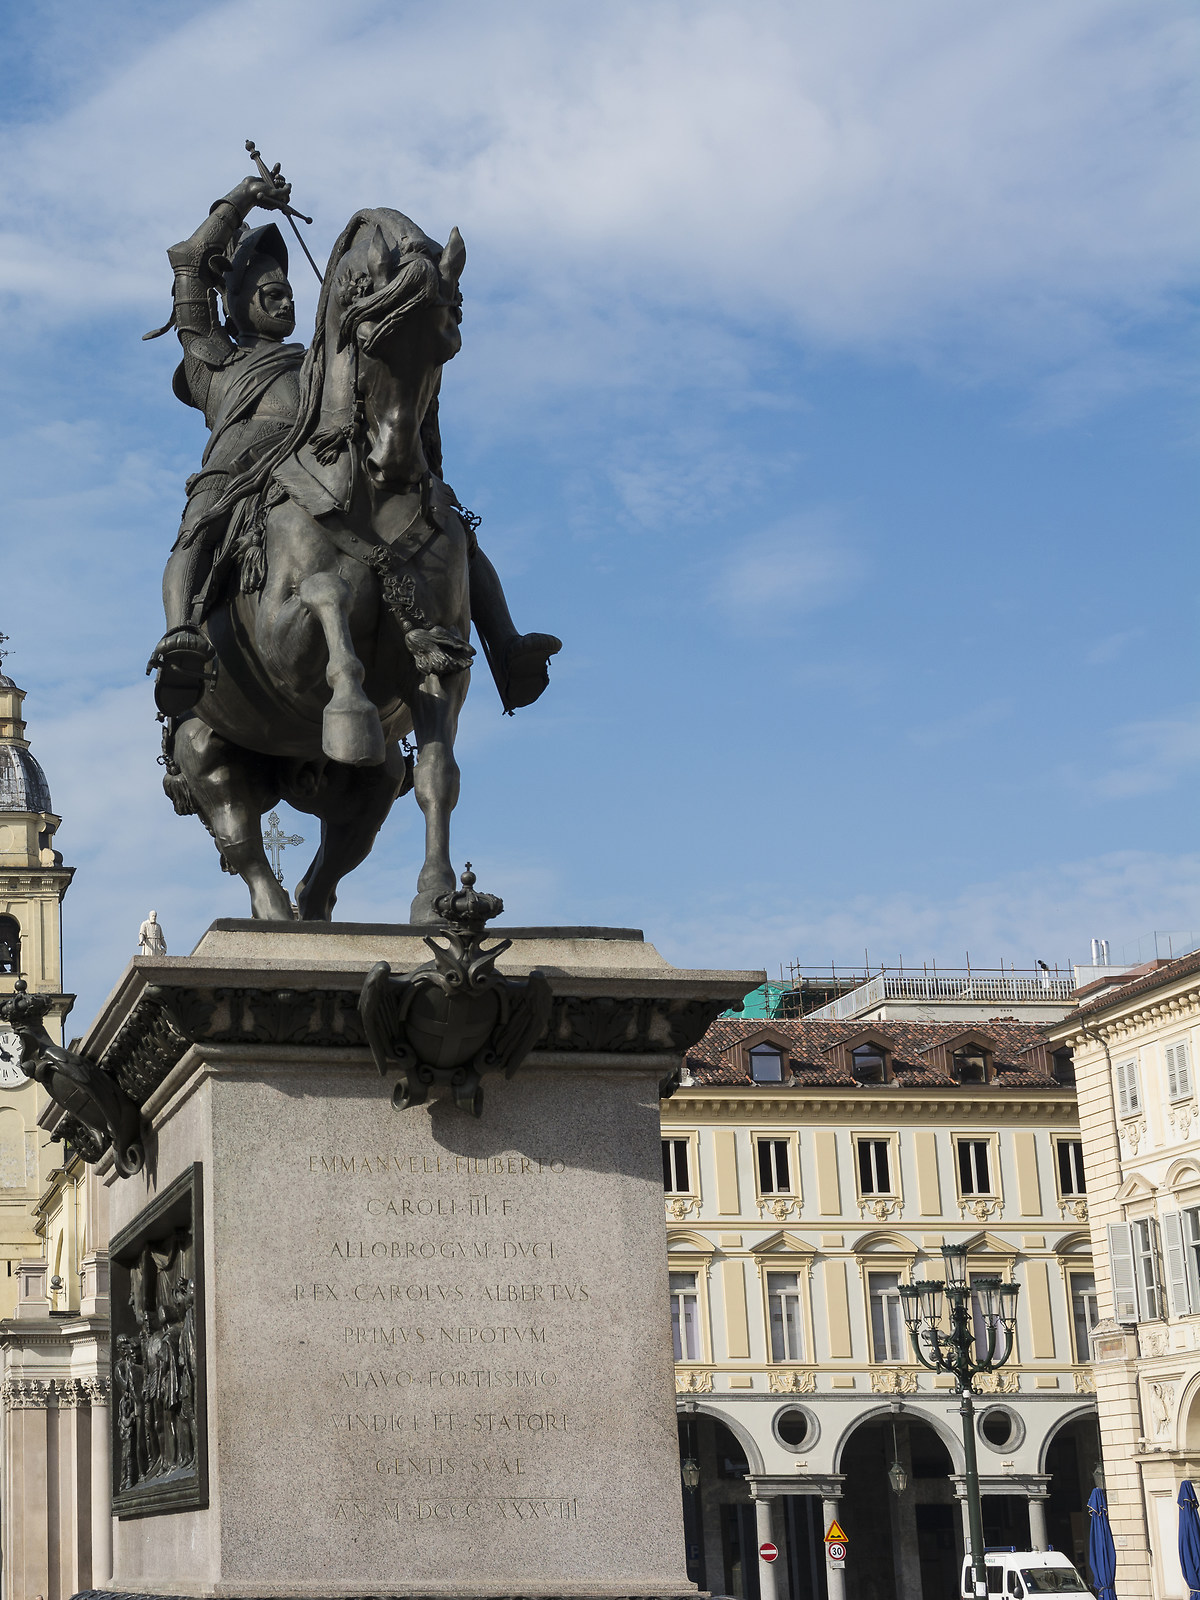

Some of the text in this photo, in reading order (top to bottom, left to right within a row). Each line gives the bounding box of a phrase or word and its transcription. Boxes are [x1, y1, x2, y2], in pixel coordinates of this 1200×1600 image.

[455, 1156, 567, 1174] FILIBERTO
[330, 1241, 489, 1259] ALLOBROGVM
[295, 1283, 590, 1302] REX CAROLVS ALBERTVS
[343, 1326, 426, 1344] PRIMVS
[428, 1370, 558, 1388] FORTISSIMO
[433, 1413, 457, 1431] ET
[375, 1457, 527, 1475] GENTIS SVAE
[831, 1547, 843, 1556] 30
